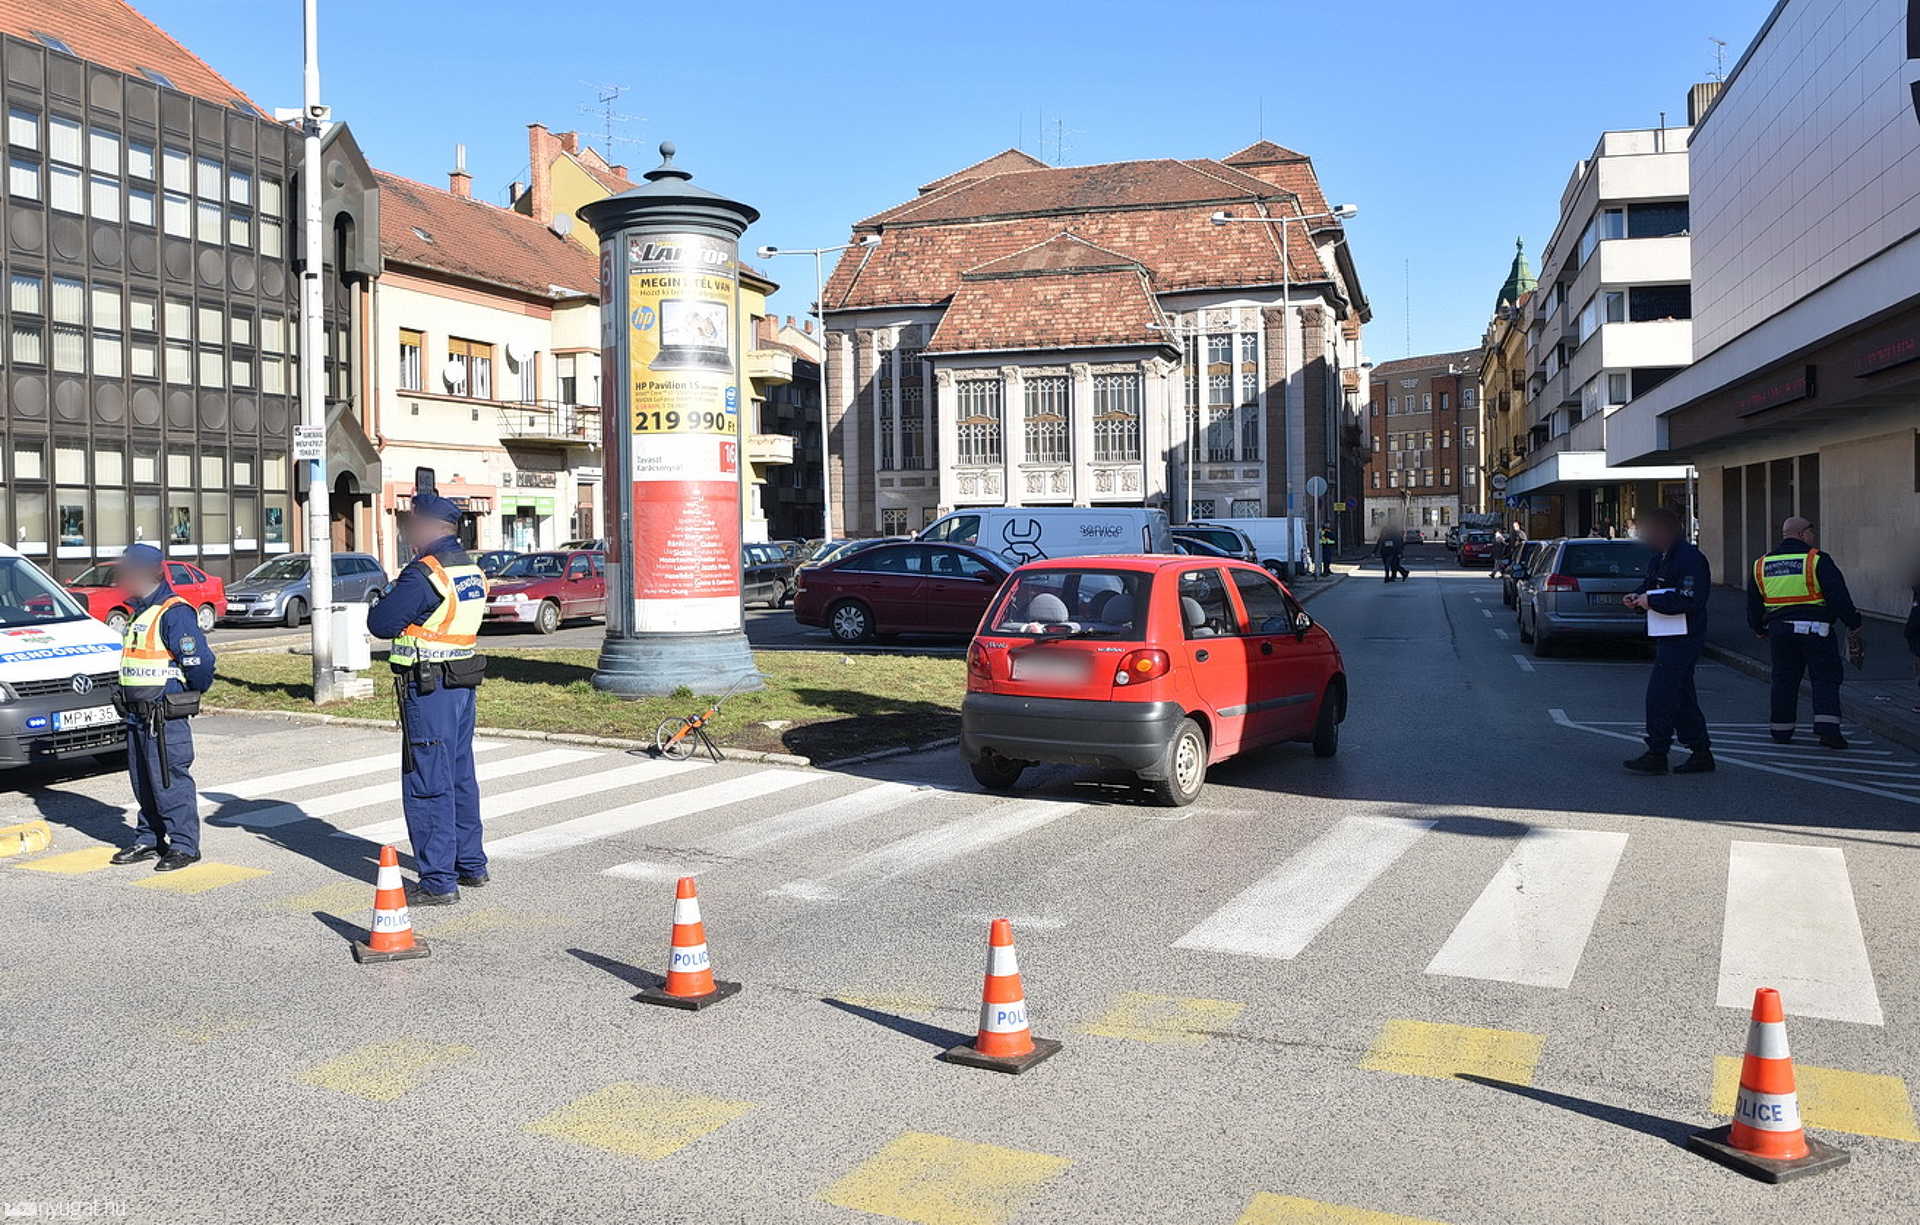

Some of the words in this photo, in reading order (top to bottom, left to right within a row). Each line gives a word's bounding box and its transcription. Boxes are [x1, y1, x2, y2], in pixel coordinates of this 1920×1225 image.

[640, 277, 689, 288] MEGIN
[635, 381, 647, 391] HP
[648, 379, 687, 390] Pavilion
[635, 411, 680, 431] 219
[687, 411, 725, 431] 990
[63, 706, 119, 726] MPW-35
